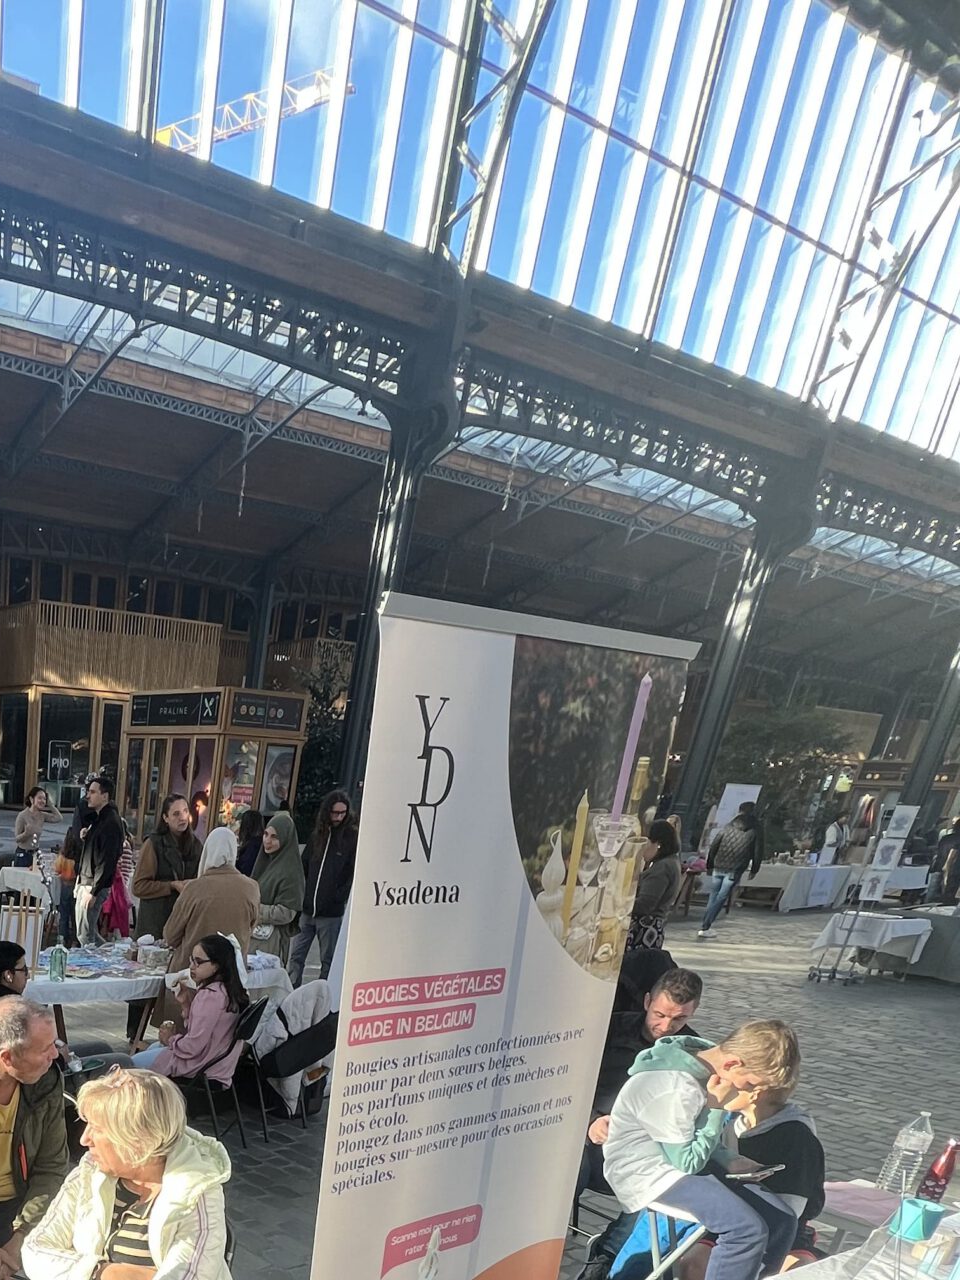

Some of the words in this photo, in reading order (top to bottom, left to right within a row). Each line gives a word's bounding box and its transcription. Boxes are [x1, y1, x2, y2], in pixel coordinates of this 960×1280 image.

[158, 706, 188, 715] PRALINE
[372, 879, 460, 907] Ysadena
[354, 983, 420, 1007] BOUGIES
[424, 974, 503, 999] VÉGÉTALES
[349, 1019, 393, 1042] MADE
[396, 1017, 412, 1035] IN
[414, 1009, 473, 1033] BELGIUM
[346, 1057, 399, 1077] Bougies
[402, 1044, 471, 1068] artisanales
[474, 1031, 561, 1056] confectionnées
[563, 1028, 585, 1041] avec
[341, 1101, 364, 1117] Des
[367, 1090, 426, 1115] parfums
[428, 1080, 474, 1099] uniques
[476, 1076, 488, 1090] et
[491, 1073, 511, 1087] des
[514, 1066, 555, 1084] mèches
[557, 1064, 569, 1076] en
[343, 1080, 388, 1098] amour
[390, 1074, 416, 1092] par
[418, 1069, 445, 1085] deux
[448, 1061, 486, 1078] sœurs
[488, 1054, 527, 1072] belges.
[336, 1134, 390, 1156] Plongez
[393, 1128, 424, 1144] dans
[425, 1121, 447, 1136] nos
[448, 1111, 498, 1134] gammes
[500, 1102, 541, 1120] maison
[543, 1098, 553, 1111] et
[555, 1095, 573, 1109] nos
[338, 1118, 366, 1137] bois
[369, 1111, 409, 1130] écolo.
[334, 1153, 386, 1175] bougies
[389, 1135, 459, 1163] sur-mesure
[460, 1128, 489, 1148] pour
[491, 1124, 511, 1139] des
[513, 1113, 564, 1133] occasions
[331, 1170, 396, 1195] spéciales.
[390, 1230, 418, 1246] Scanne
[418, 1224, 432, 1236] moi
[451, 1218, 461, 1227] ne
[462, 1214, 477, 1224] rien
[404, 1243, 425, 1256] rater
